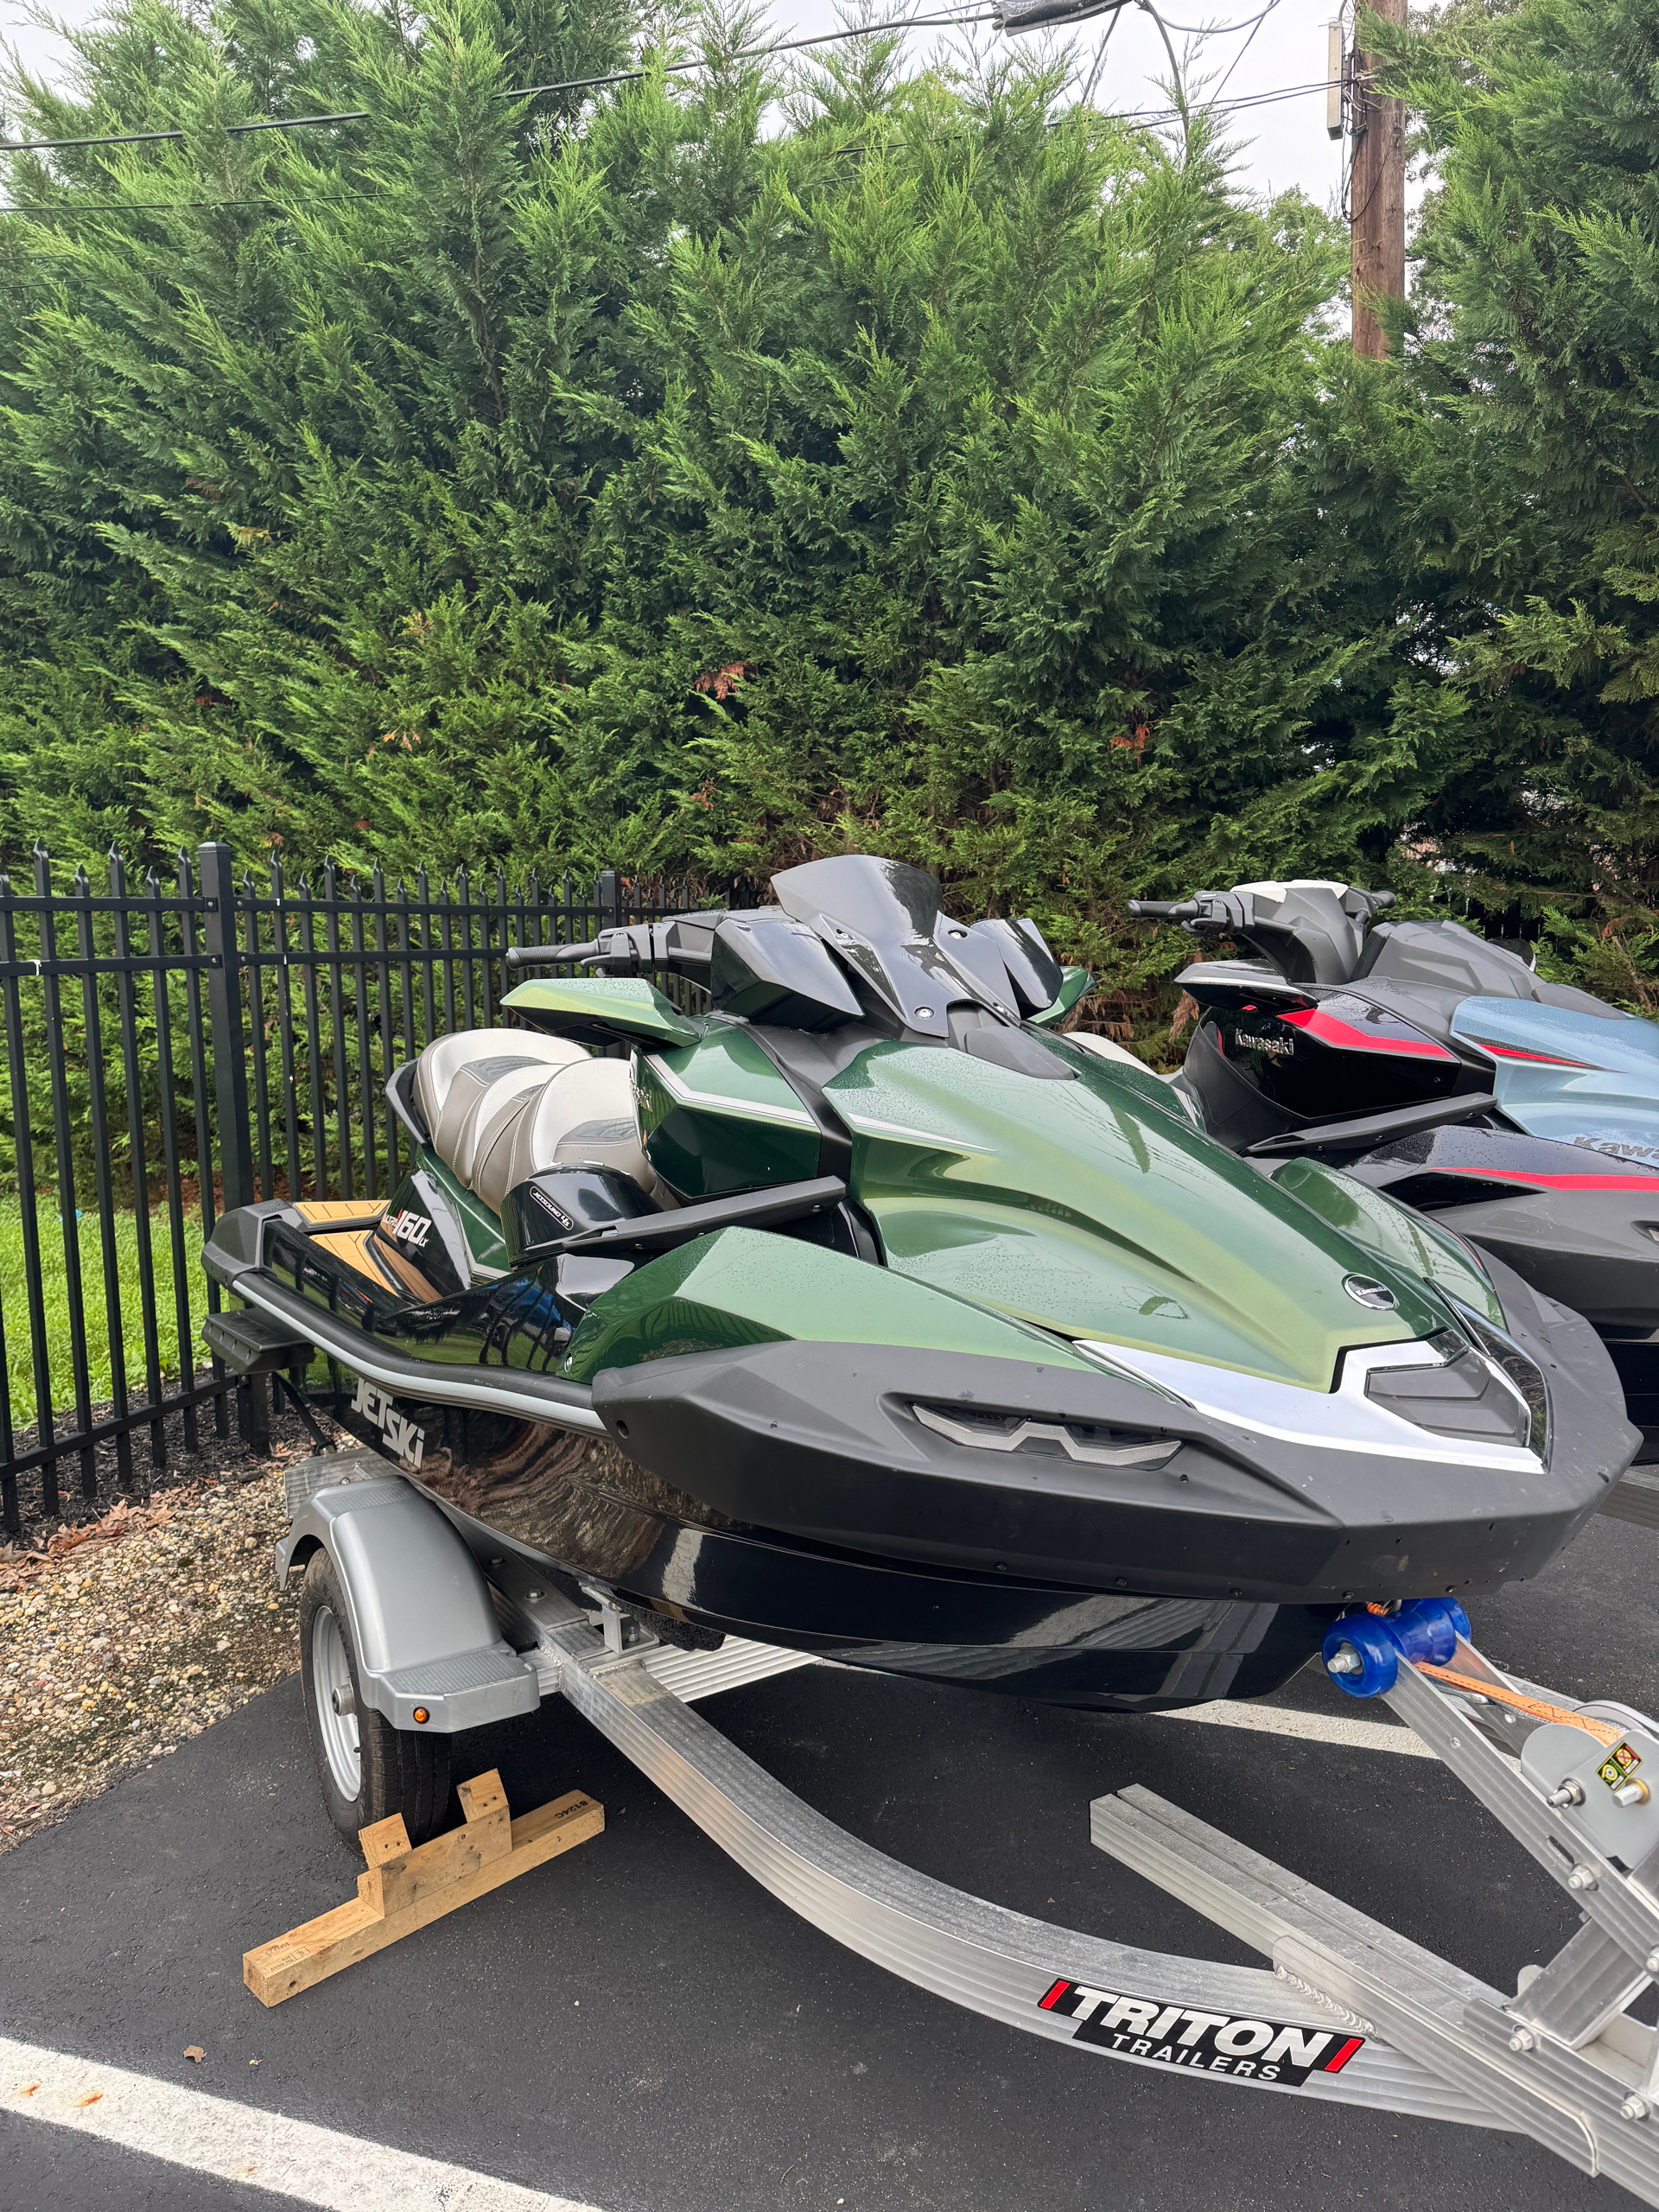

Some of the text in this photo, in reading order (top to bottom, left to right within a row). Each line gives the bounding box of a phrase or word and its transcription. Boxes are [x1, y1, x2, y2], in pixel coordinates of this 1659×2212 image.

[1235, 1028, 1294, 1056] Kawasaki
[392, 1210, 432, 1244] 160
[1071, 1986, 1334, 2068] TRITON
[1111, 2033, 1281, 2081] TRAILERS
